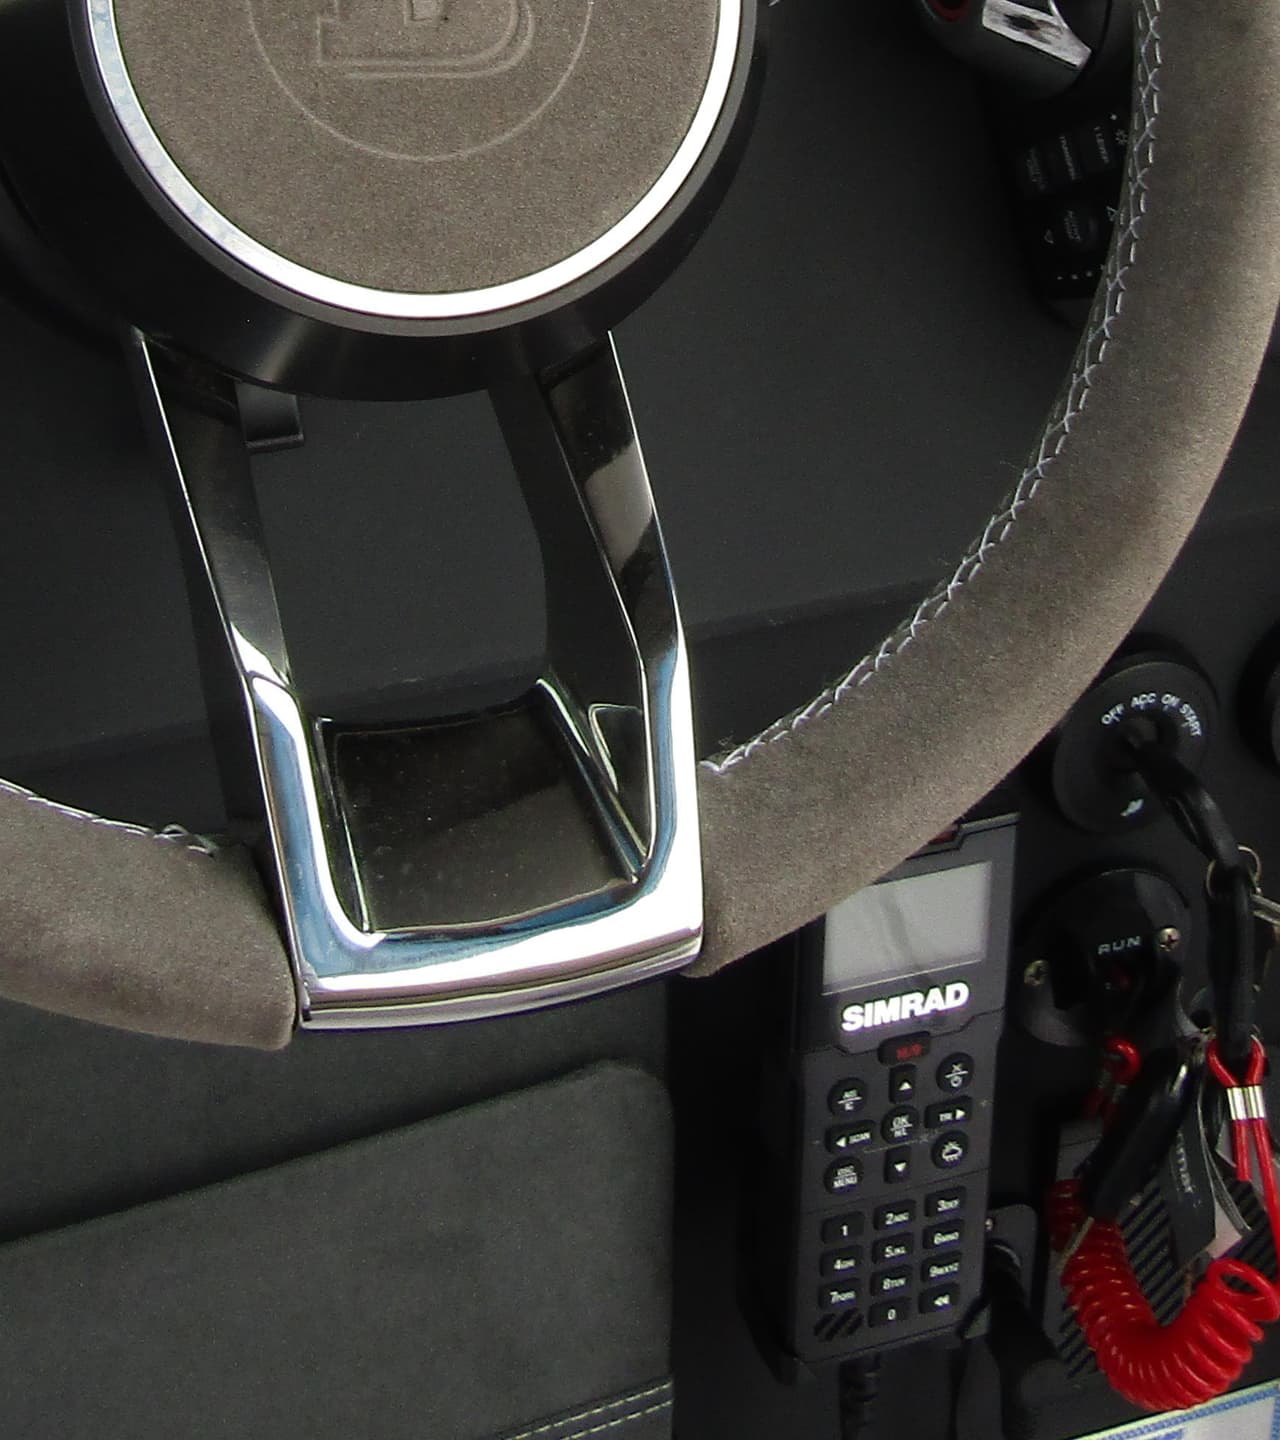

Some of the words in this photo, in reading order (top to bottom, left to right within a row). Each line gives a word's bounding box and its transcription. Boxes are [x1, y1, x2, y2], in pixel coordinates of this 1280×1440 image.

[1101, 704, 1125, 725] OFF
[1130, 692, 1157, 708] ACC
[1161, 693, 1180, 707] ON
[1180, 703, 1202, 736] START
[1098, 935, 1142, 955] RUN
[841, 981, 970, 1032] SIMRAD
[892, 1115, 910, 1128] OK
[840, 1224, 849, 1236] 1
[887, 1308, 897, 1320] 0
